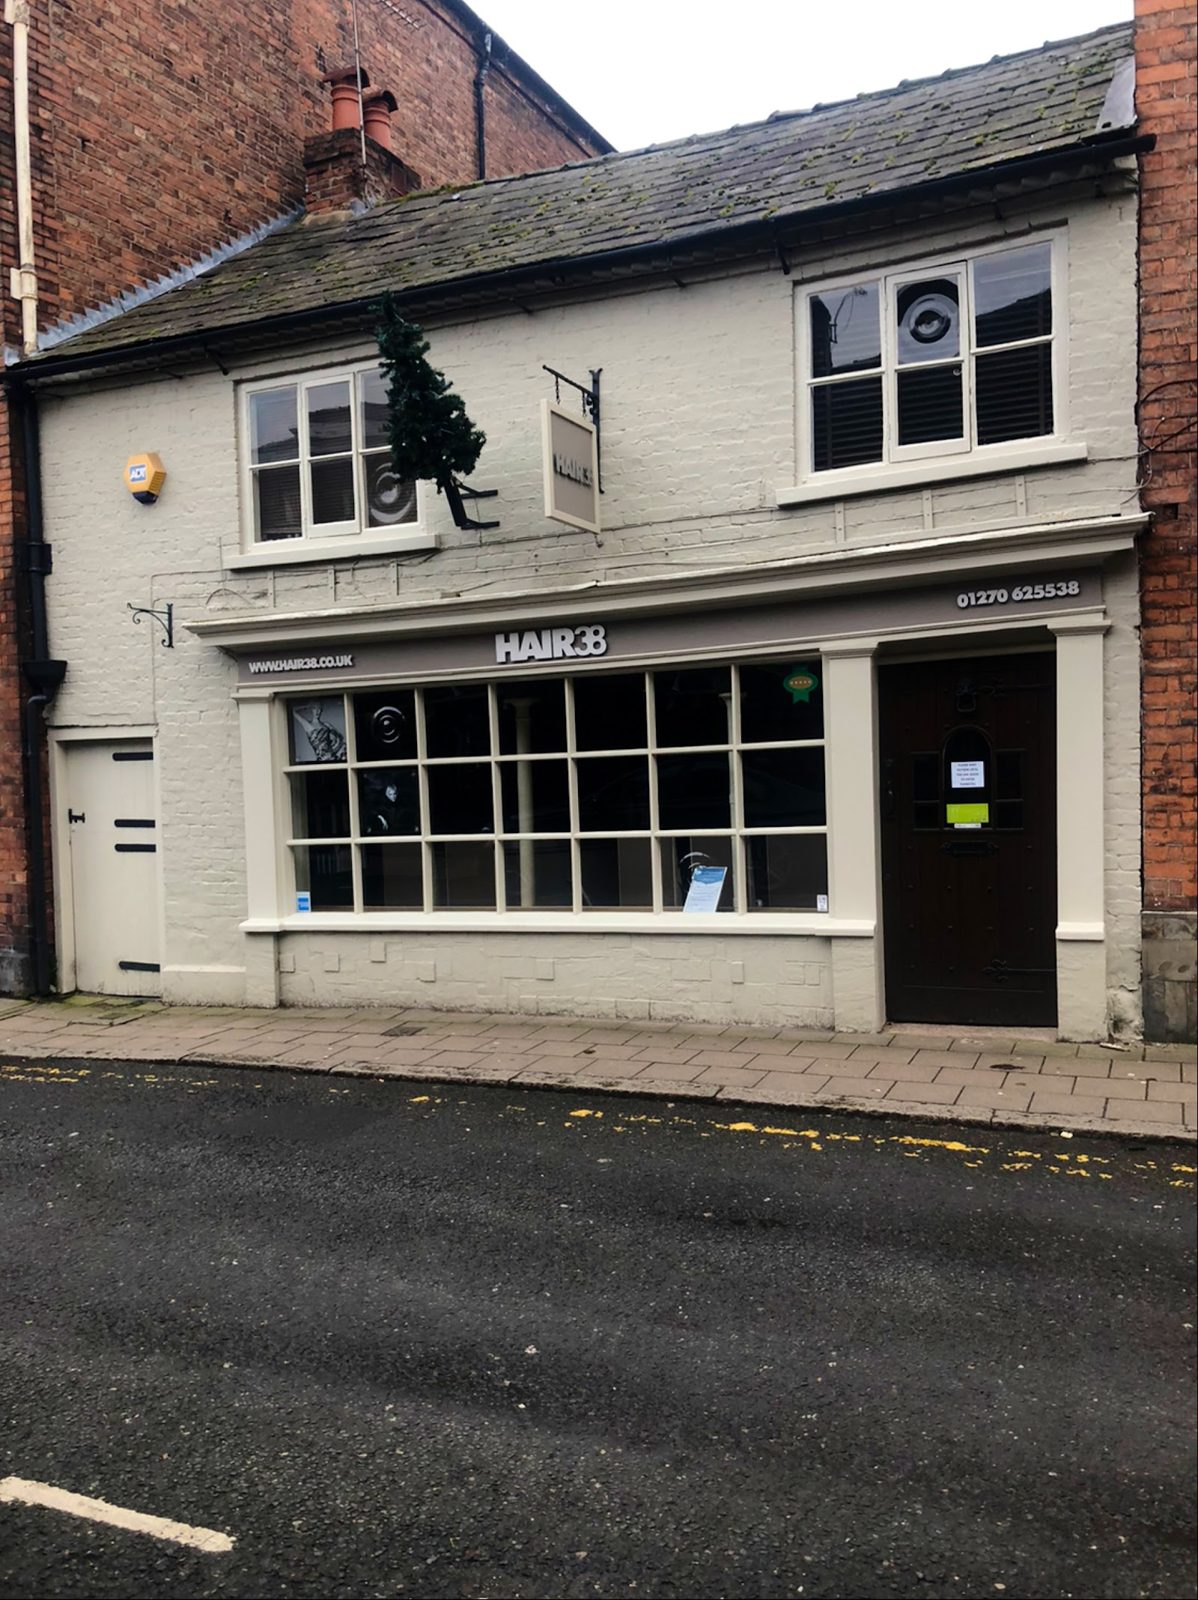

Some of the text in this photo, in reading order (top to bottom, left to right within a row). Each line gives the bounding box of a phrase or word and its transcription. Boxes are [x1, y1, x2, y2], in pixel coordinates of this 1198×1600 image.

[129, 466, 146, 480] ADT
[957, 580, 1080, 608] 01270 625538
[495, 624, 607, 663] HAIR38
[248, 654, 353, 673] WWW.HAIR38.CO.UK
